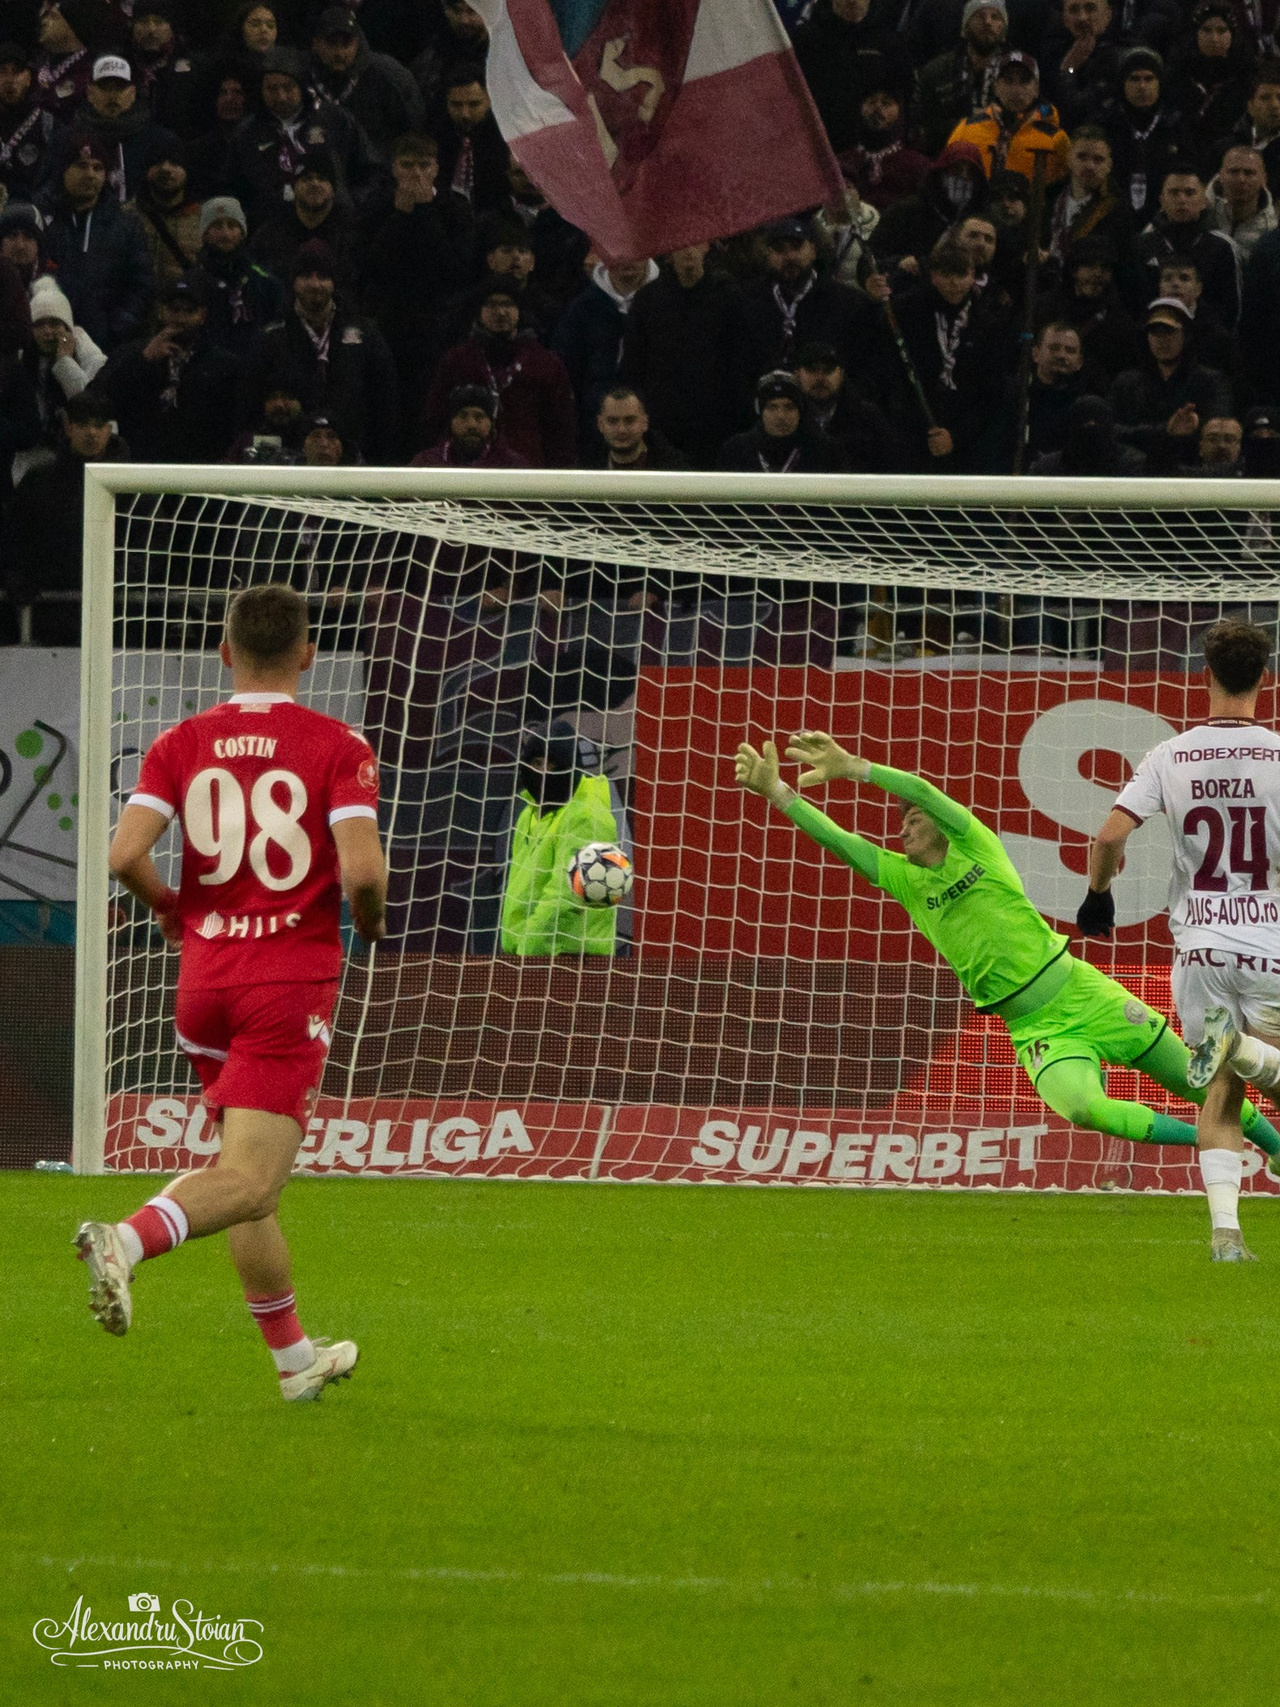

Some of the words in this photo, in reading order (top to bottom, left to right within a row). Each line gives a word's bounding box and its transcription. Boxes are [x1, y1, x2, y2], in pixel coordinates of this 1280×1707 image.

[213, 736, 277, 759] COSTIN
[1190, 778, 1256, 800] BORZA
[184, 767, 312, 892] 98
[1183, 805, 1270, 892] 24
[691, 1120, 1049, 1179] SUPERBET
